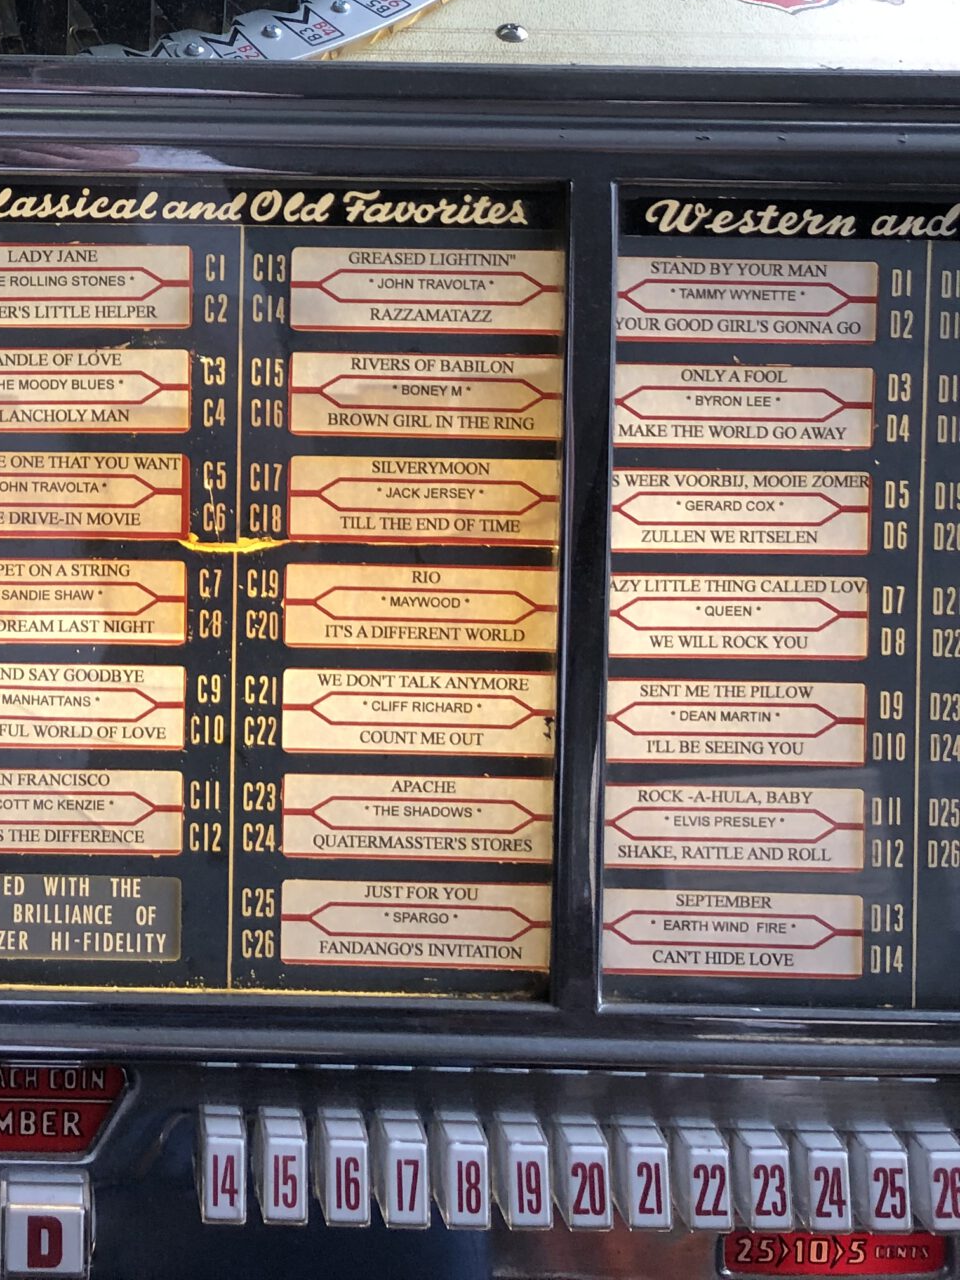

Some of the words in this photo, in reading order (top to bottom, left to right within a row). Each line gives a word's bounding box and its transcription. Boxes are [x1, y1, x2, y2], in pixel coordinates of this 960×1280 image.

[311, 20, 337, 36] B4
[161, 191, 248, 221] and
[249, 189, 335, 222] Old
[342, 189, 528, 225] Favorites
[645, 199, 857, 237] Western
[871, 203, 960, 237] and
[7, 249, 54, 263] LADY
[56, 249, 98, 263] JANE
[205, 253, 225, 282] C1
[650, 260, 706, 275] STAND
[709, 262, 735, 276] BY
[736, 262, 785, 277] YOUR
[787, 263, 828, 278] MAN
[377, 277, 414, 290] JOHN
[417, 278, 487, 291] TRAVOLTA
[891, 268, 912, 298] D1
[678, 287, 727, 300] TAMMY
[729, 289, 797, 302] WYNETTE
[369, 307, 493, 323] RAZZAMATAZZ
[680, 368, 727, 383] ONLY
[727, 370, 741, 383] A
[744, 369, 788, 384] FOOL
[401, 384, 448, 397] BONEY
[451, 385, 463, 397] M
[641, 529, 706, 543] ZULLEN
[709, 529, 736, 544] WE
[739, 530, 819, 544] RITSELEN
[1, 589, 51, 601] SANDIE
[54, 589, 95, 601] SHAW
[704, 605, 753, 617] QUEEN
[649, 635, 674, 649] WE
[677, 635, 719, 649] WILL
[721, 635, 769, 649] ROCK
[772, 635, 809, 650] YOU
[1, 693, 92, 708] MANHATTANS
[371, 700, 409, 712] CLIFF
[412, 701, 473, 714] RICHARD
[679, 710, 717, 722] DEAN
[720, 710, 772, 723] MARTIN
[17, 773, 111, 787] FRANCISCO
[391, 779, 457, 794] APACHE
[673, 815, 711, 828] ELVIS
[714, 815, 777, 829] PRESLEY
[43, 876, 90, 897] WITH
[109, 877, 141, 899] THE
[675, 894, 773, 910] SEPTEMBER
[13, 903, 113, 925] BRILLIANCE
[135, 905, 157, 926] OF
[393, 911, 450, 925] SPARGO
[663, 919, 709, 932] EARTH
[711, 921, 750, 933] WIND
[756, 921, 787, 935] FIRE
[51, 931, 167, 954] HI-FIDELITY
[49, 1068, 105, 1089] COIN
[212, 1154, 239, 1208] 14
[335, 1156, 361, 1211] 16
[457, 1160, 482, 1215] 18
[570, 1161, 606, 1216] 20
[693, 1163, 728, 1217] 22
[813, 1166, 847, 1219] 24
[872, 1166, 907, 1220] 25
[26, 1215, 63, 1269] D
[874, 1245, 930, 1259] CENTS
